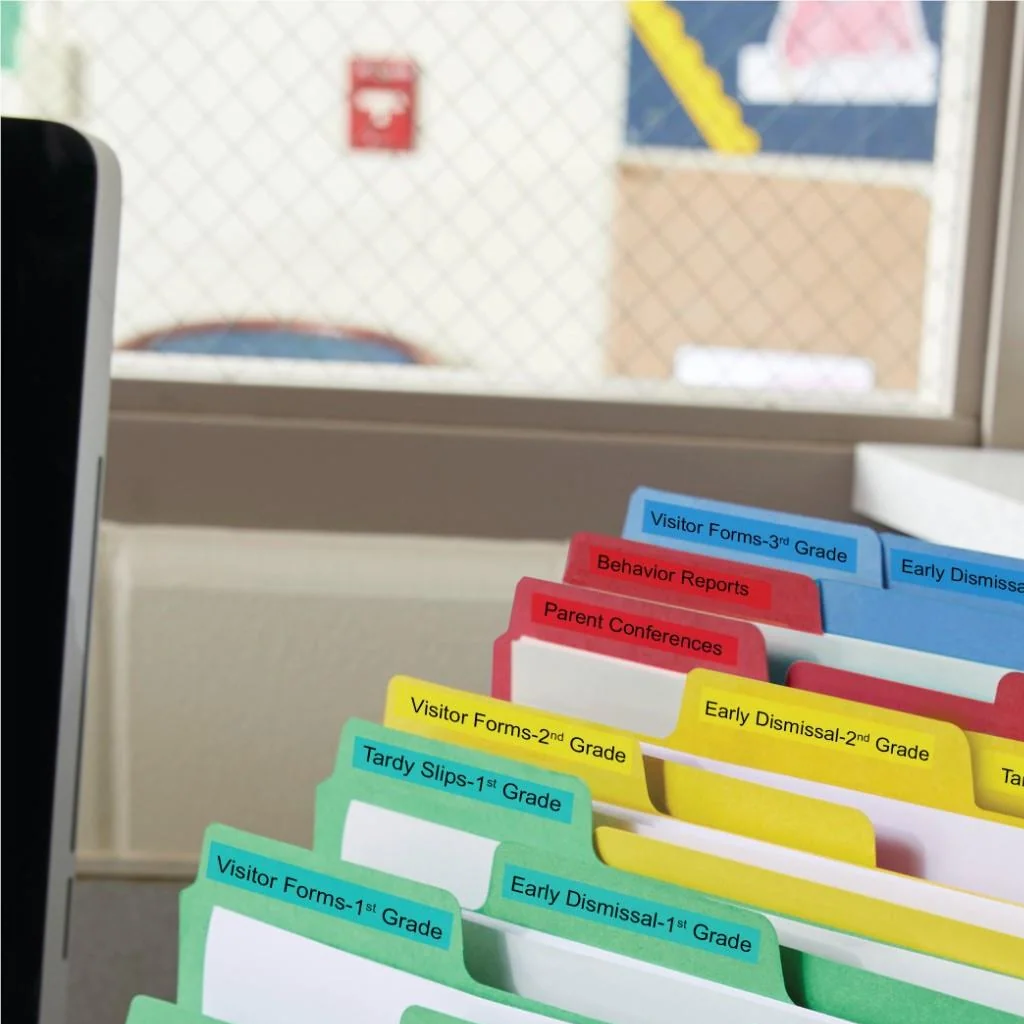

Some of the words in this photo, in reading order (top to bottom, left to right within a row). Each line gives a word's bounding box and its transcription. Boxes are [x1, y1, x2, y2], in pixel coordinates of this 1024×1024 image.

[650, 511, 704, 534] Visitor
[794, 540, 848, 564] Grade
[597, 554, 676, 582] Behavior
[681, 570, 749, 596] Reports
[901, 558, 945, 582] Early
[544, 601, 603, 628] Parent
[609, 617, 723, 656] Conferences
[411, 697, 468, 725] Visitor
[569, 736, 626, 763] Grade
[705, 700, 749, 726] Early
[875, 737, 930, 762] Grade
[363, 745, 415, 776] Tardy
[502, 783, 562, 812] Grade
[217, 855, 278, 889] Visitor
[382, 908, 443, 940] Grade
[511, 875, 561, 906] Early
[693, 923, 752, 953] Grade
